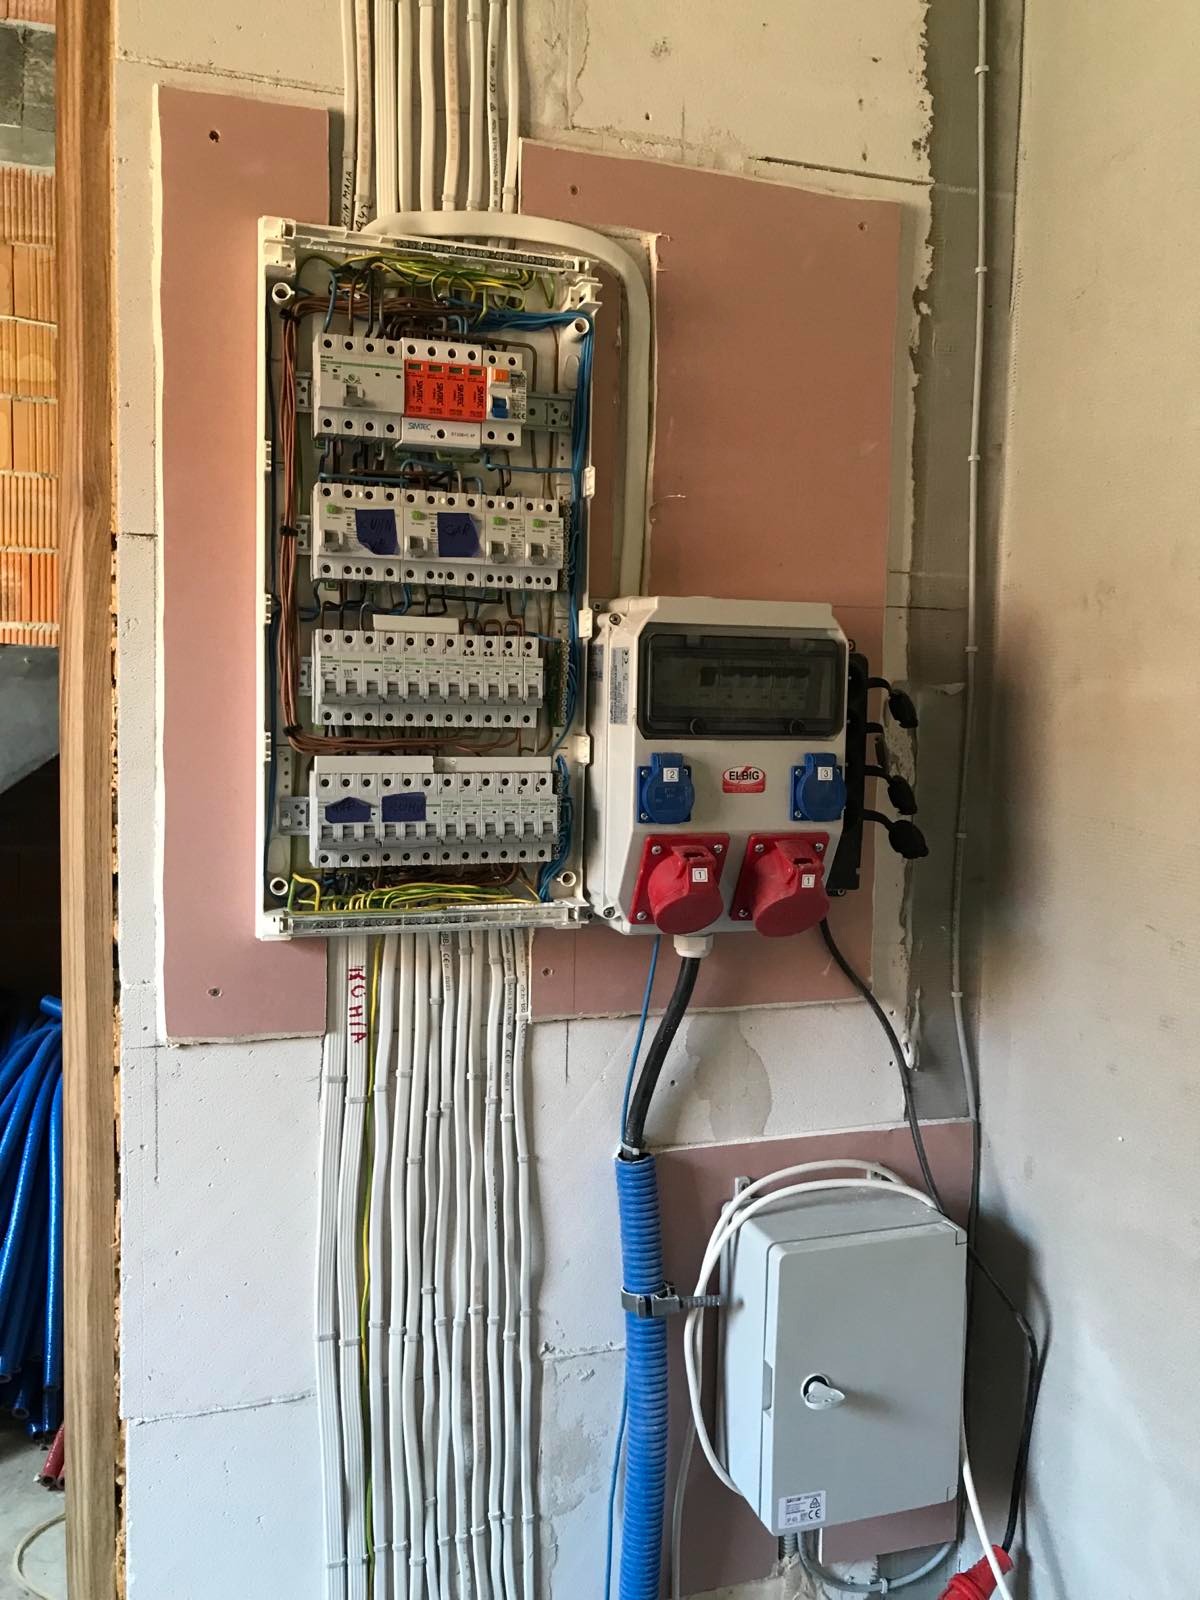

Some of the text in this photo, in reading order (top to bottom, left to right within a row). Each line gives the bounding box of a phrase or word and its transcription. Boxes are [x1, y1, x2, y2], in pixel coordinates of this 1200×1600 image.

[416, 380, 424, 404] SIMTEC
[436, 382, 444, 406] SIMTEC
[456, 384, 464, 407] SIMTEC
[476, 385, 484, 409] SIMTEC
[408, 422, 431, 431] SIMTEC
[729, 771, 760, 781] ELBIG
